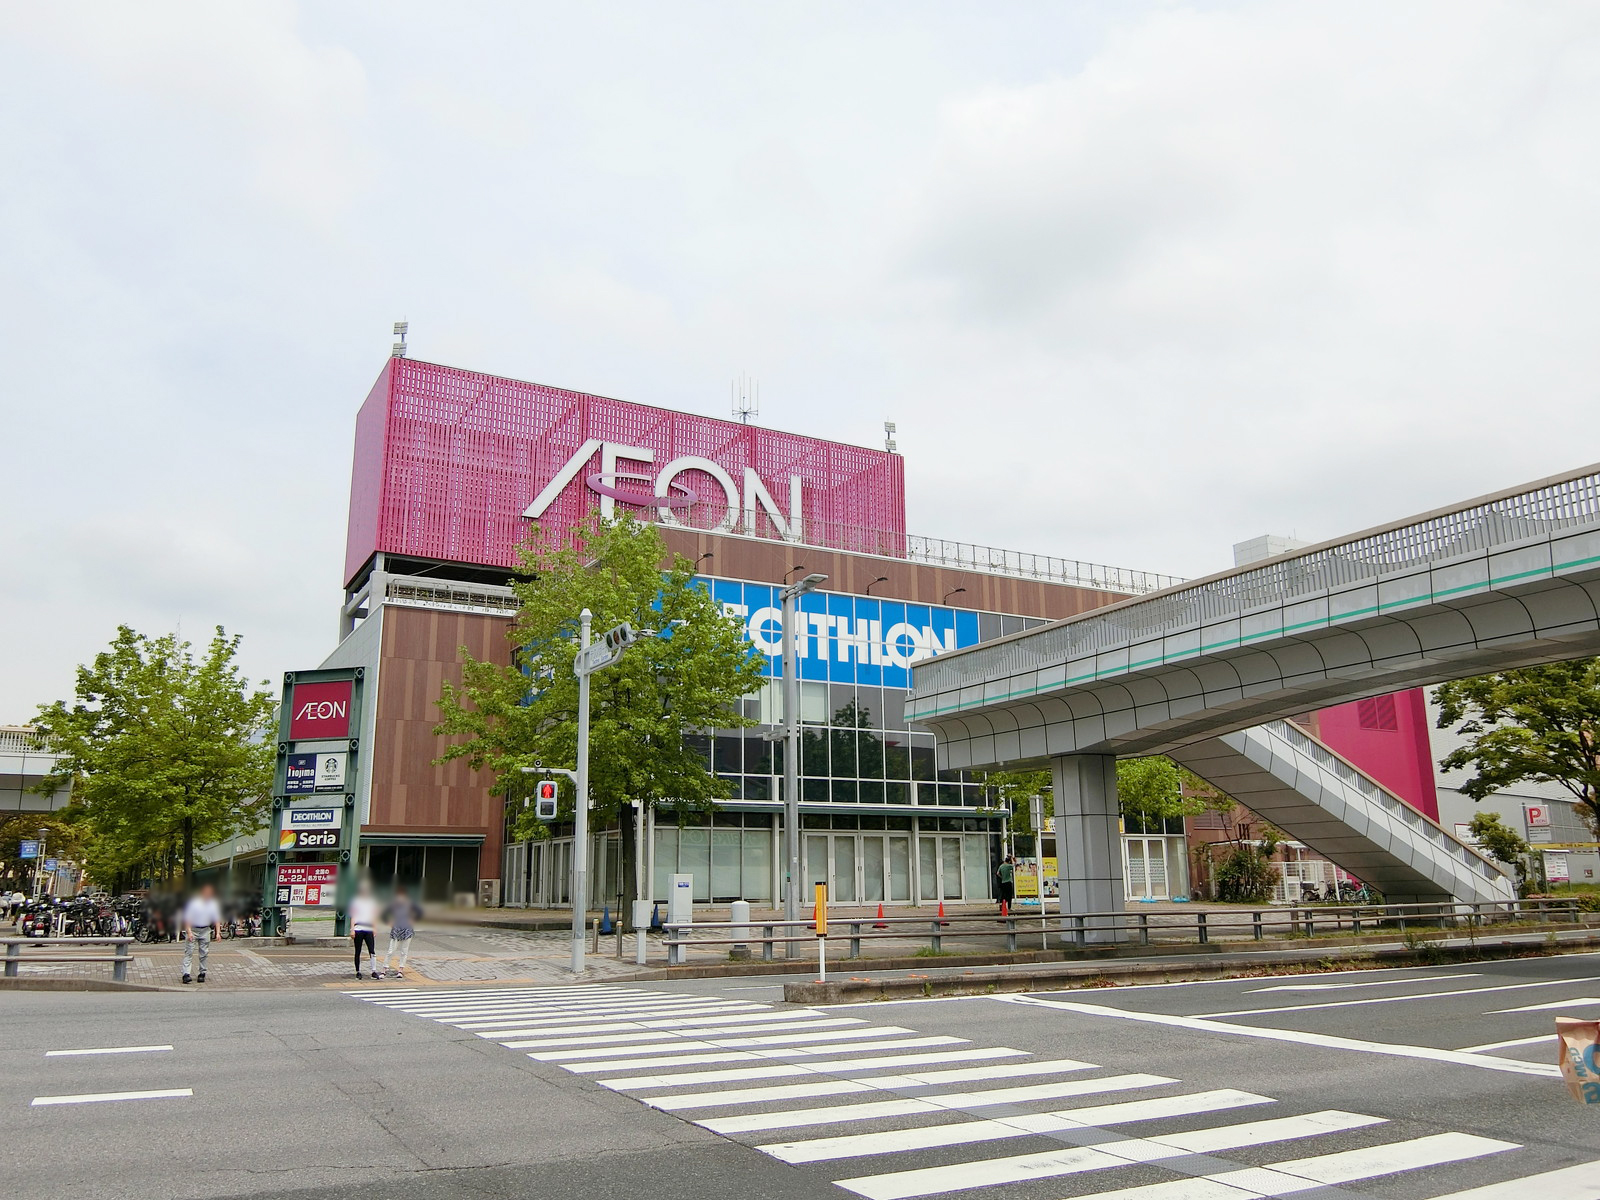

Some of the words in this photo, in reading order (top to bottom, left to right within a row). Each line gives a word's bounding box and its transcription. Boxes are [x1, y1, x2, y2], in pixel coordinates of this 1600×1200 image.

[293, 812, 332, 821] DECATHLON
[1529, 807, 1541, 824] P
[299, 830, 336, 846] Seria
[278, 889, 290, 902] 酒
[307, 888, 319, 901] 薬
